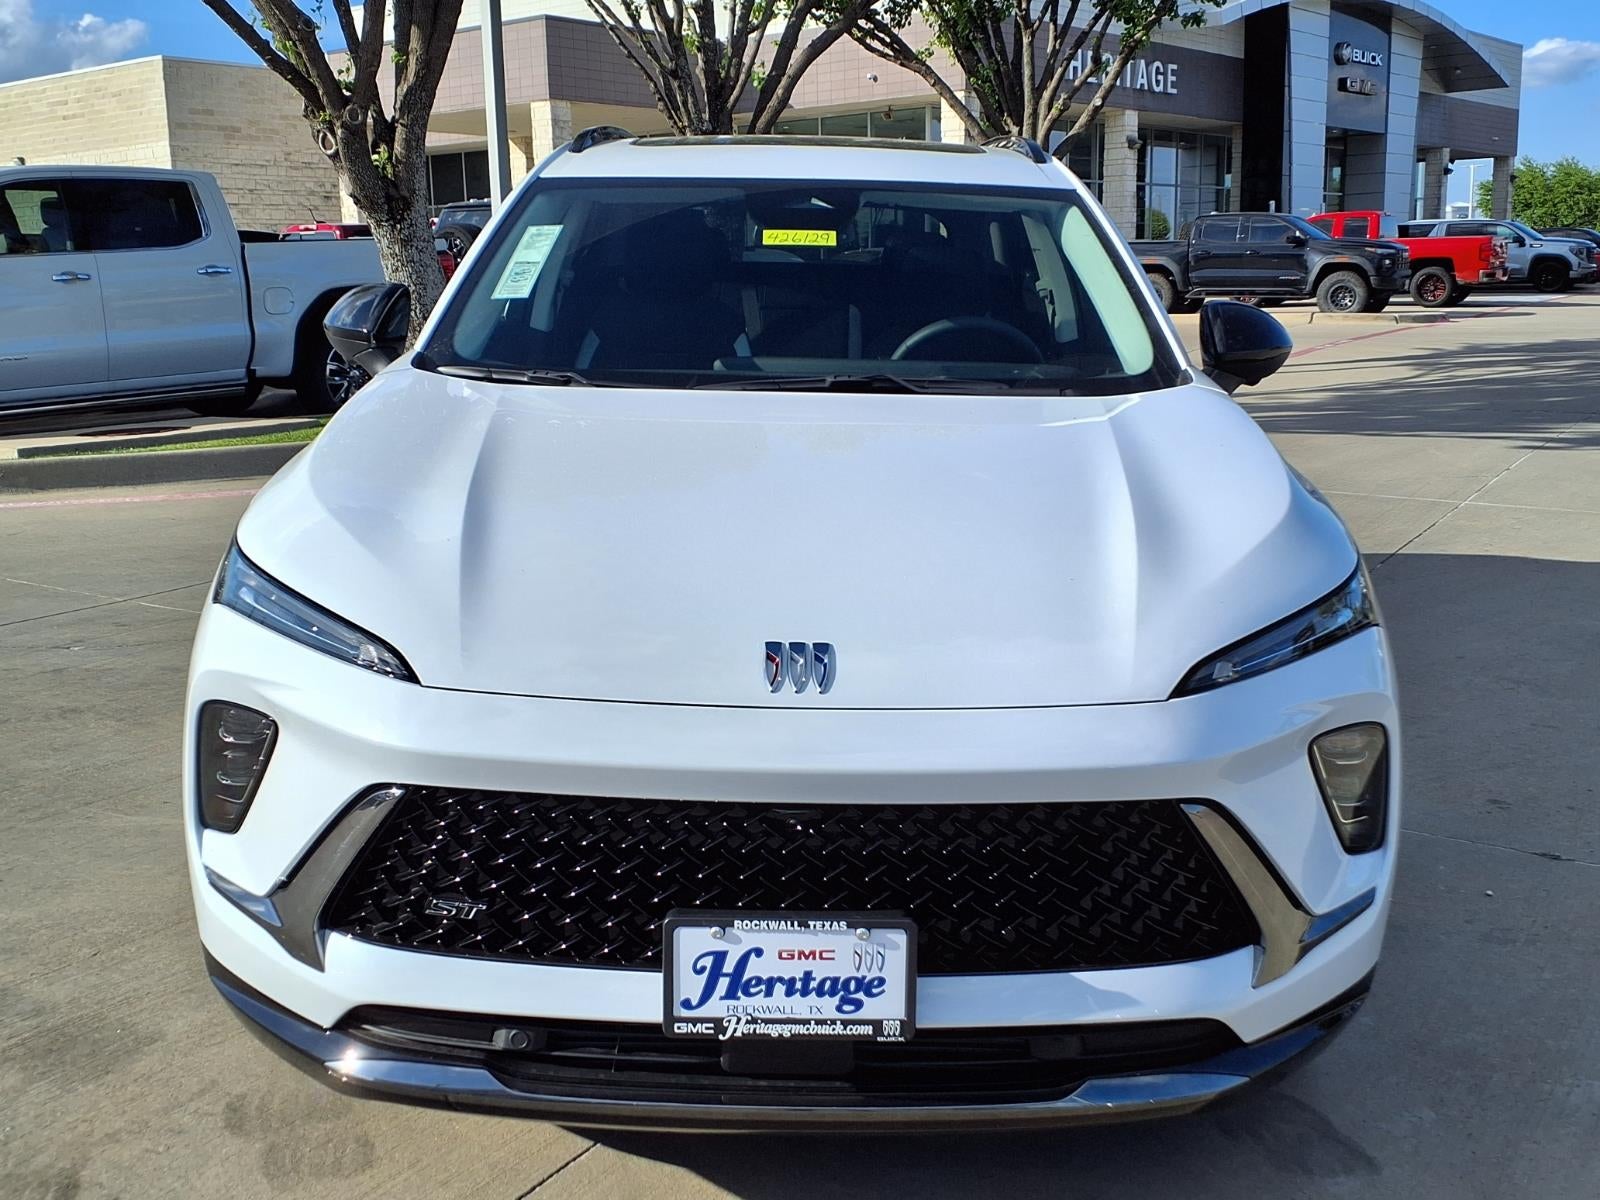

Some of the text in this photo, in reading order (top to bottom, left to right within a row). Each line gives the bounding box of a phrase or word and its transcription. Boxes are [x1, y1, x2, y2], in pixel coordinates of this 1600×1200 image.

[1353, 48, 1383, 66] BUICK
[767, 232, 830, 244] 426129
[425, 899, 487, 919] ST
[733, 919, 848, 932] ROCKWALL, TEXAS
[777, 949, 836, 961] GMC
[680, 947, 887, 1015] Heritage
[807, 1005, 823, 1016] TX
[673, 1022, 715, 1034] GMC
[718, 1016, 873, 1041] Heritagegmcbuick.com
